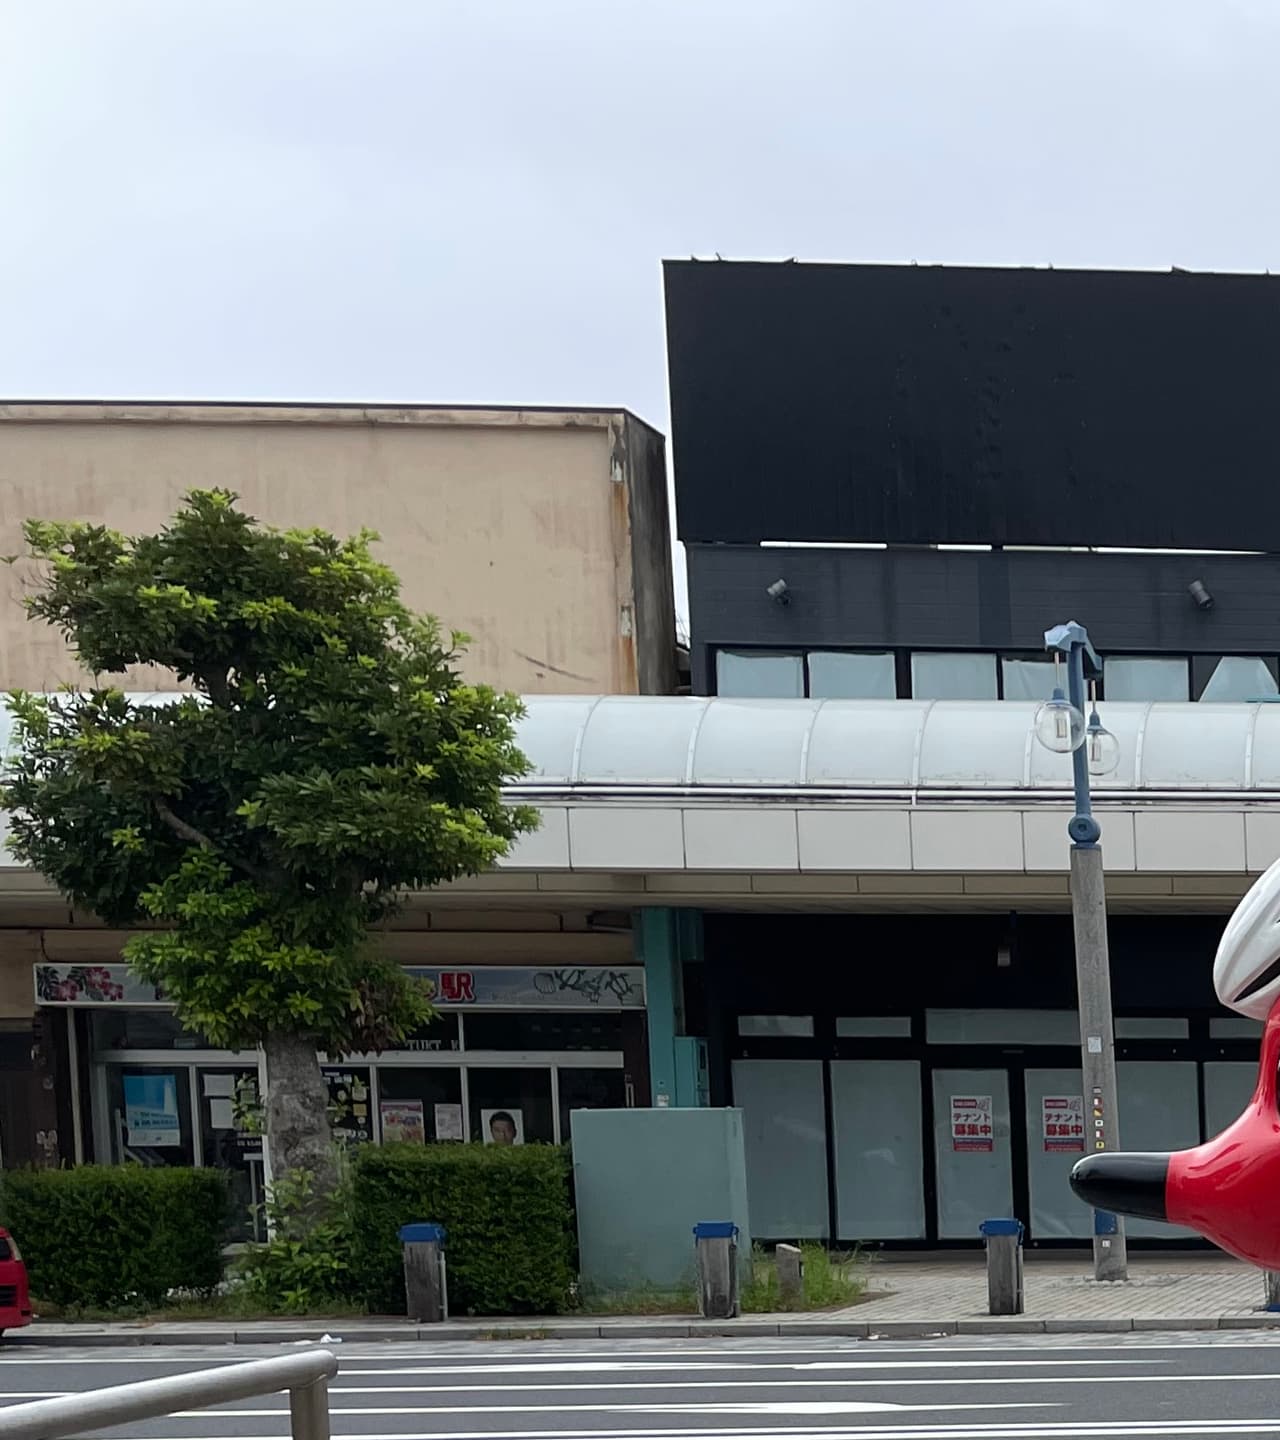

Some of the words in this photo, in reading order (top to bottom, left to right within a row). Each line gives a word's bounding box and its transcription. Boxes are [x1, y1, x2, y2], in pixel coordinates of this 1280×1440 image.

[952, 1113, 991, 1123] テナント
[1044, 1113, 1083, 1123] テナント
